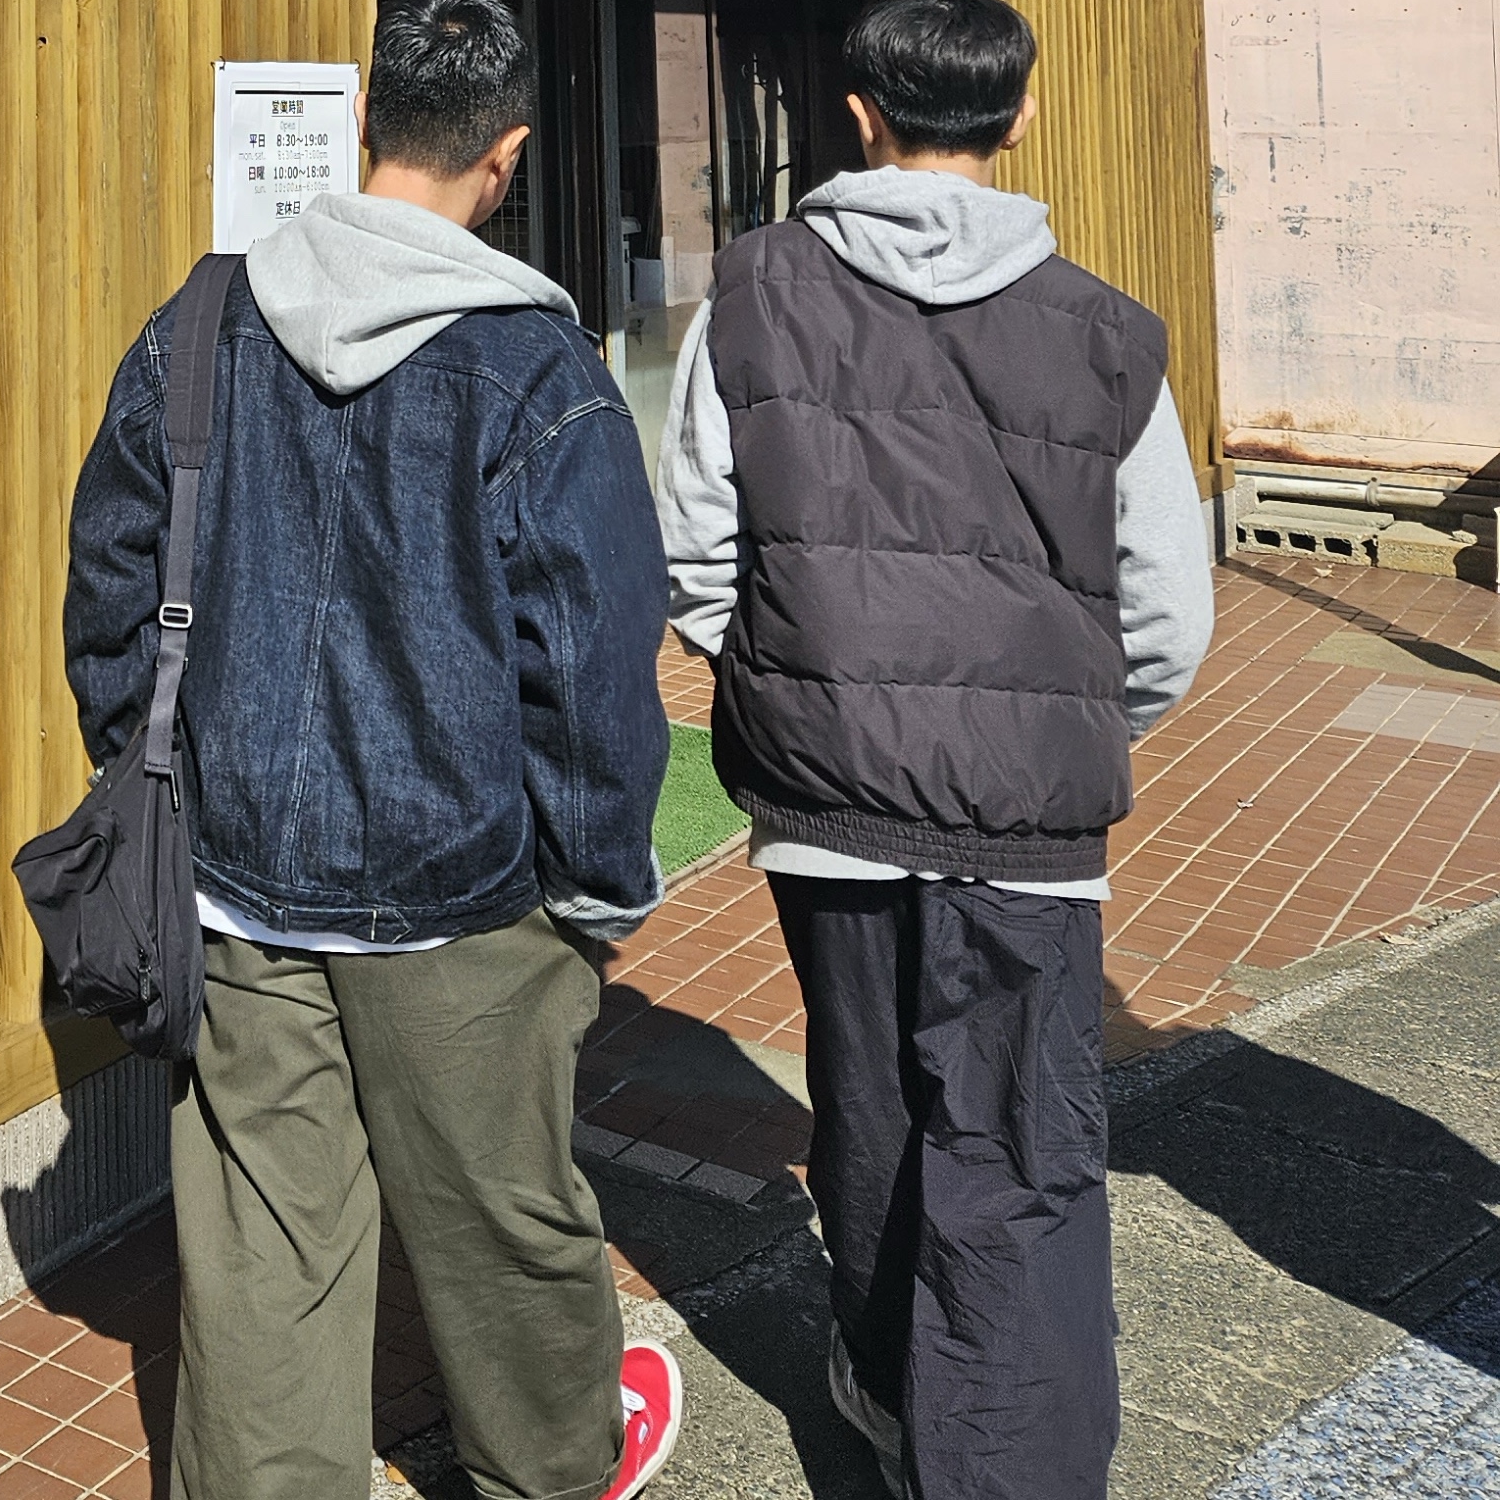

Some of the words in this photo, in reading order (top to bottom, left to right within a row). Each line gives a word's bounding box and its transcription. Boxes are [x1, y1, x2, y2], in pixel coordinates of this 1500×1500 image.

[271, 100, 303, 115] 営業時間
[249, 134, 265, 148] 平日
[248, 165, 265, 181] 日曜
[275, 200, 300, 216] 定休日
